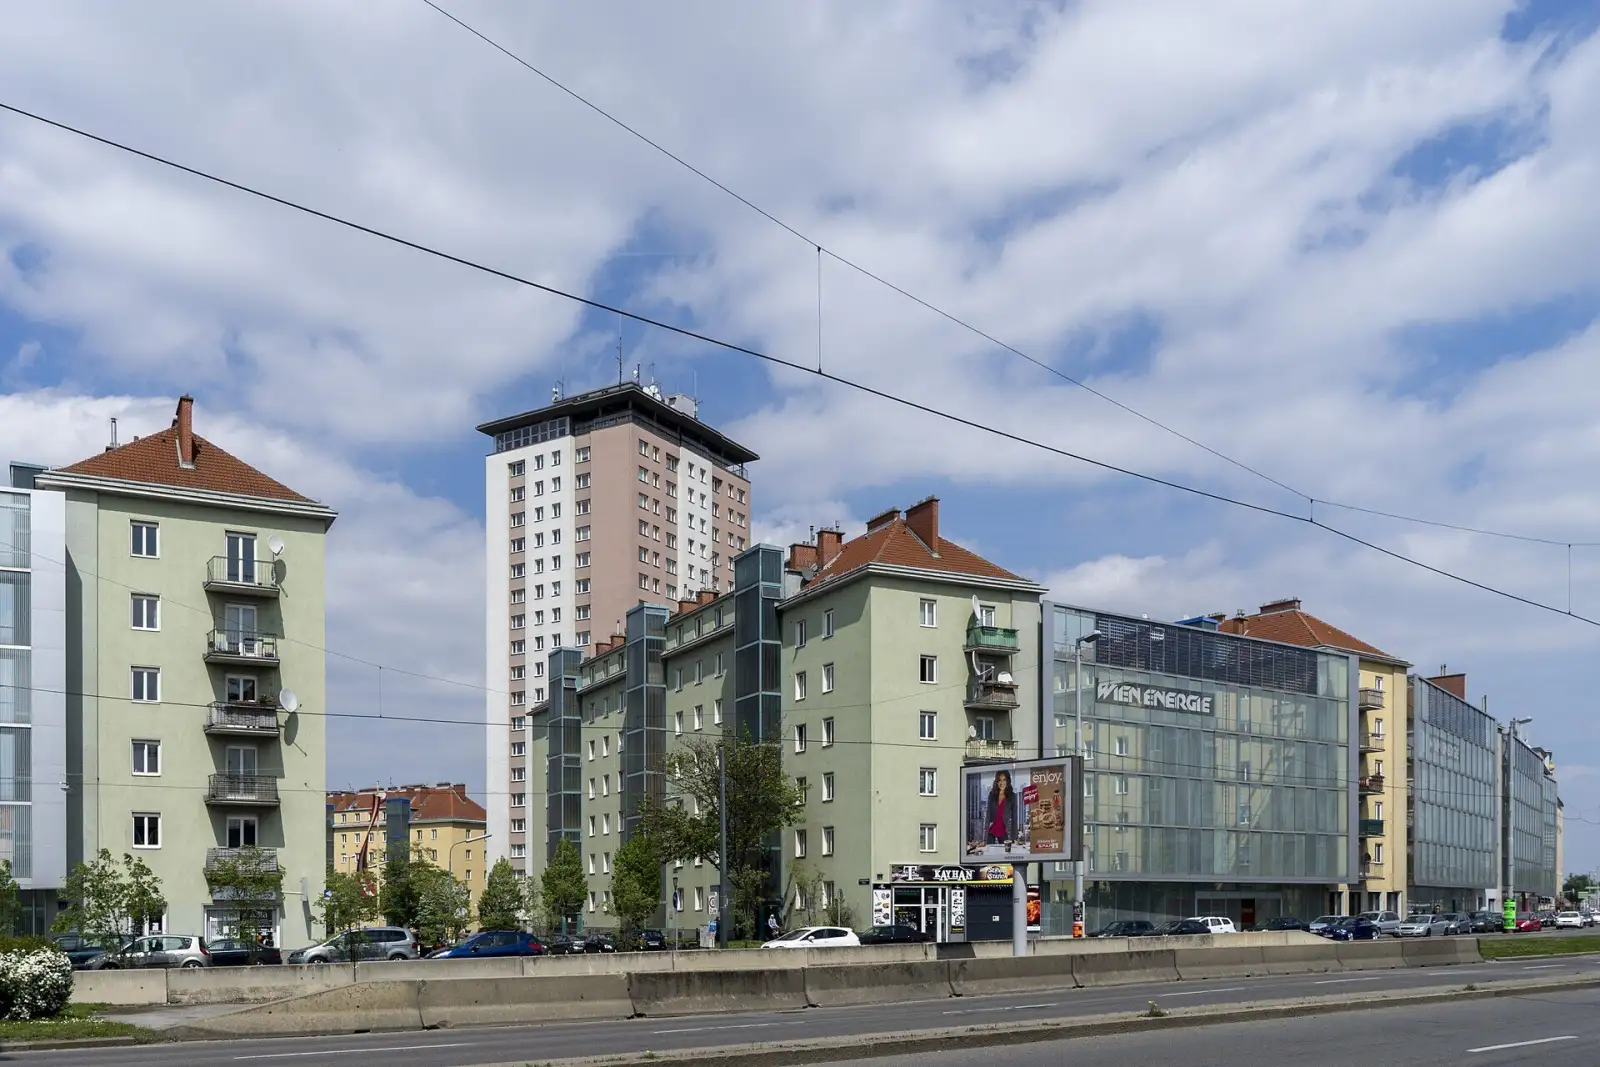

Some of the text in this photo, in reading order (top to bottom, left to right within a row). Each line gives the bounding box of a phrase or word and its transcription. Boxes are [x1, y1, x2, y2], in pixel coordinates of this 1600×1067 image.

[1097, 683, 1213, 713] WIEN ENERGIE
[934, 869, 973, 882] KAYHAN
